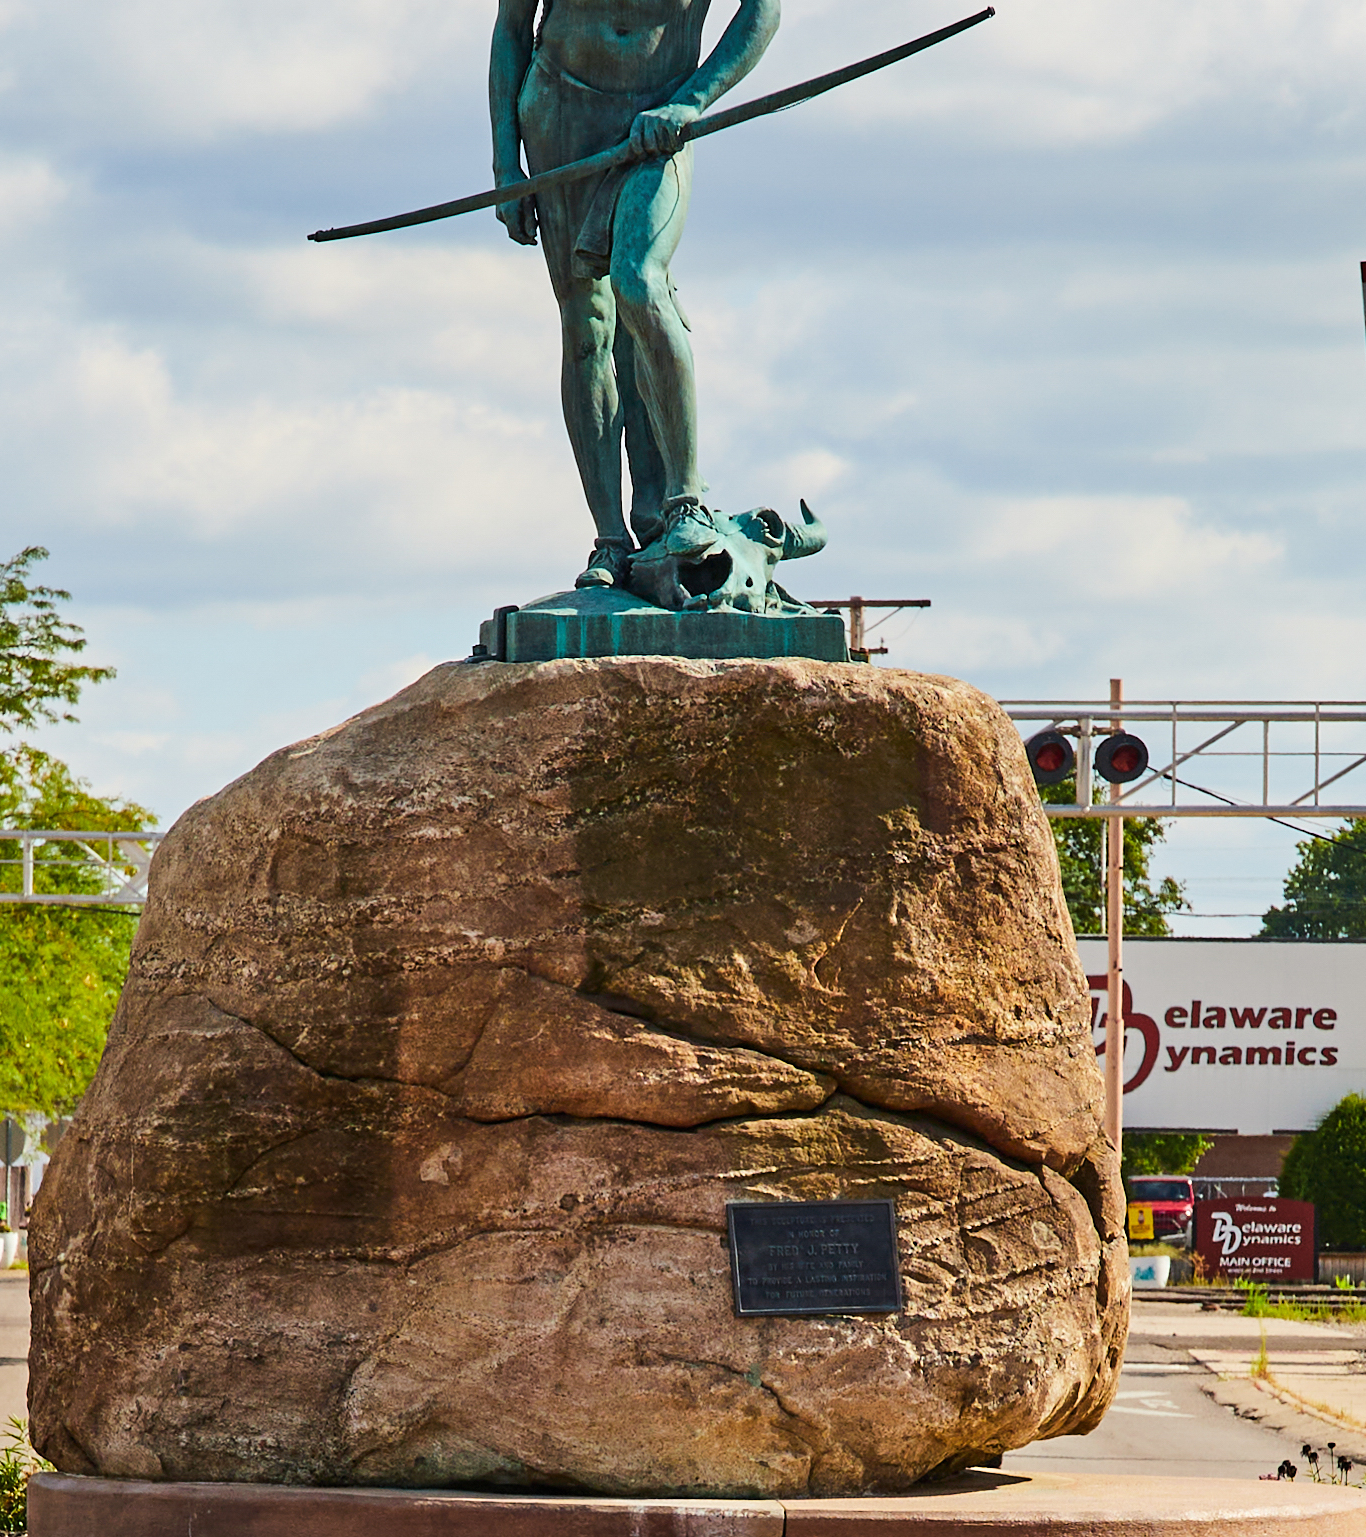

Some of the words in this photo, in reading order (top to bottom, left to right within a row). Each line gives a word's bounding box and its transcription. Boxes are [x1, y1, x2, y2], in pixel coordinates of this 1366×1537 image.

[798, 1229, 825, 1239] HONOR
[768, 1245, 799, 1256] FRED
[807, 1244, 818, 1256] J.
[821, 1242, 859, 1255] PETTY
[1219, 1257, 1250, 1267] MAIN
[1252, 1257, 1291, 1267] OFFICE
